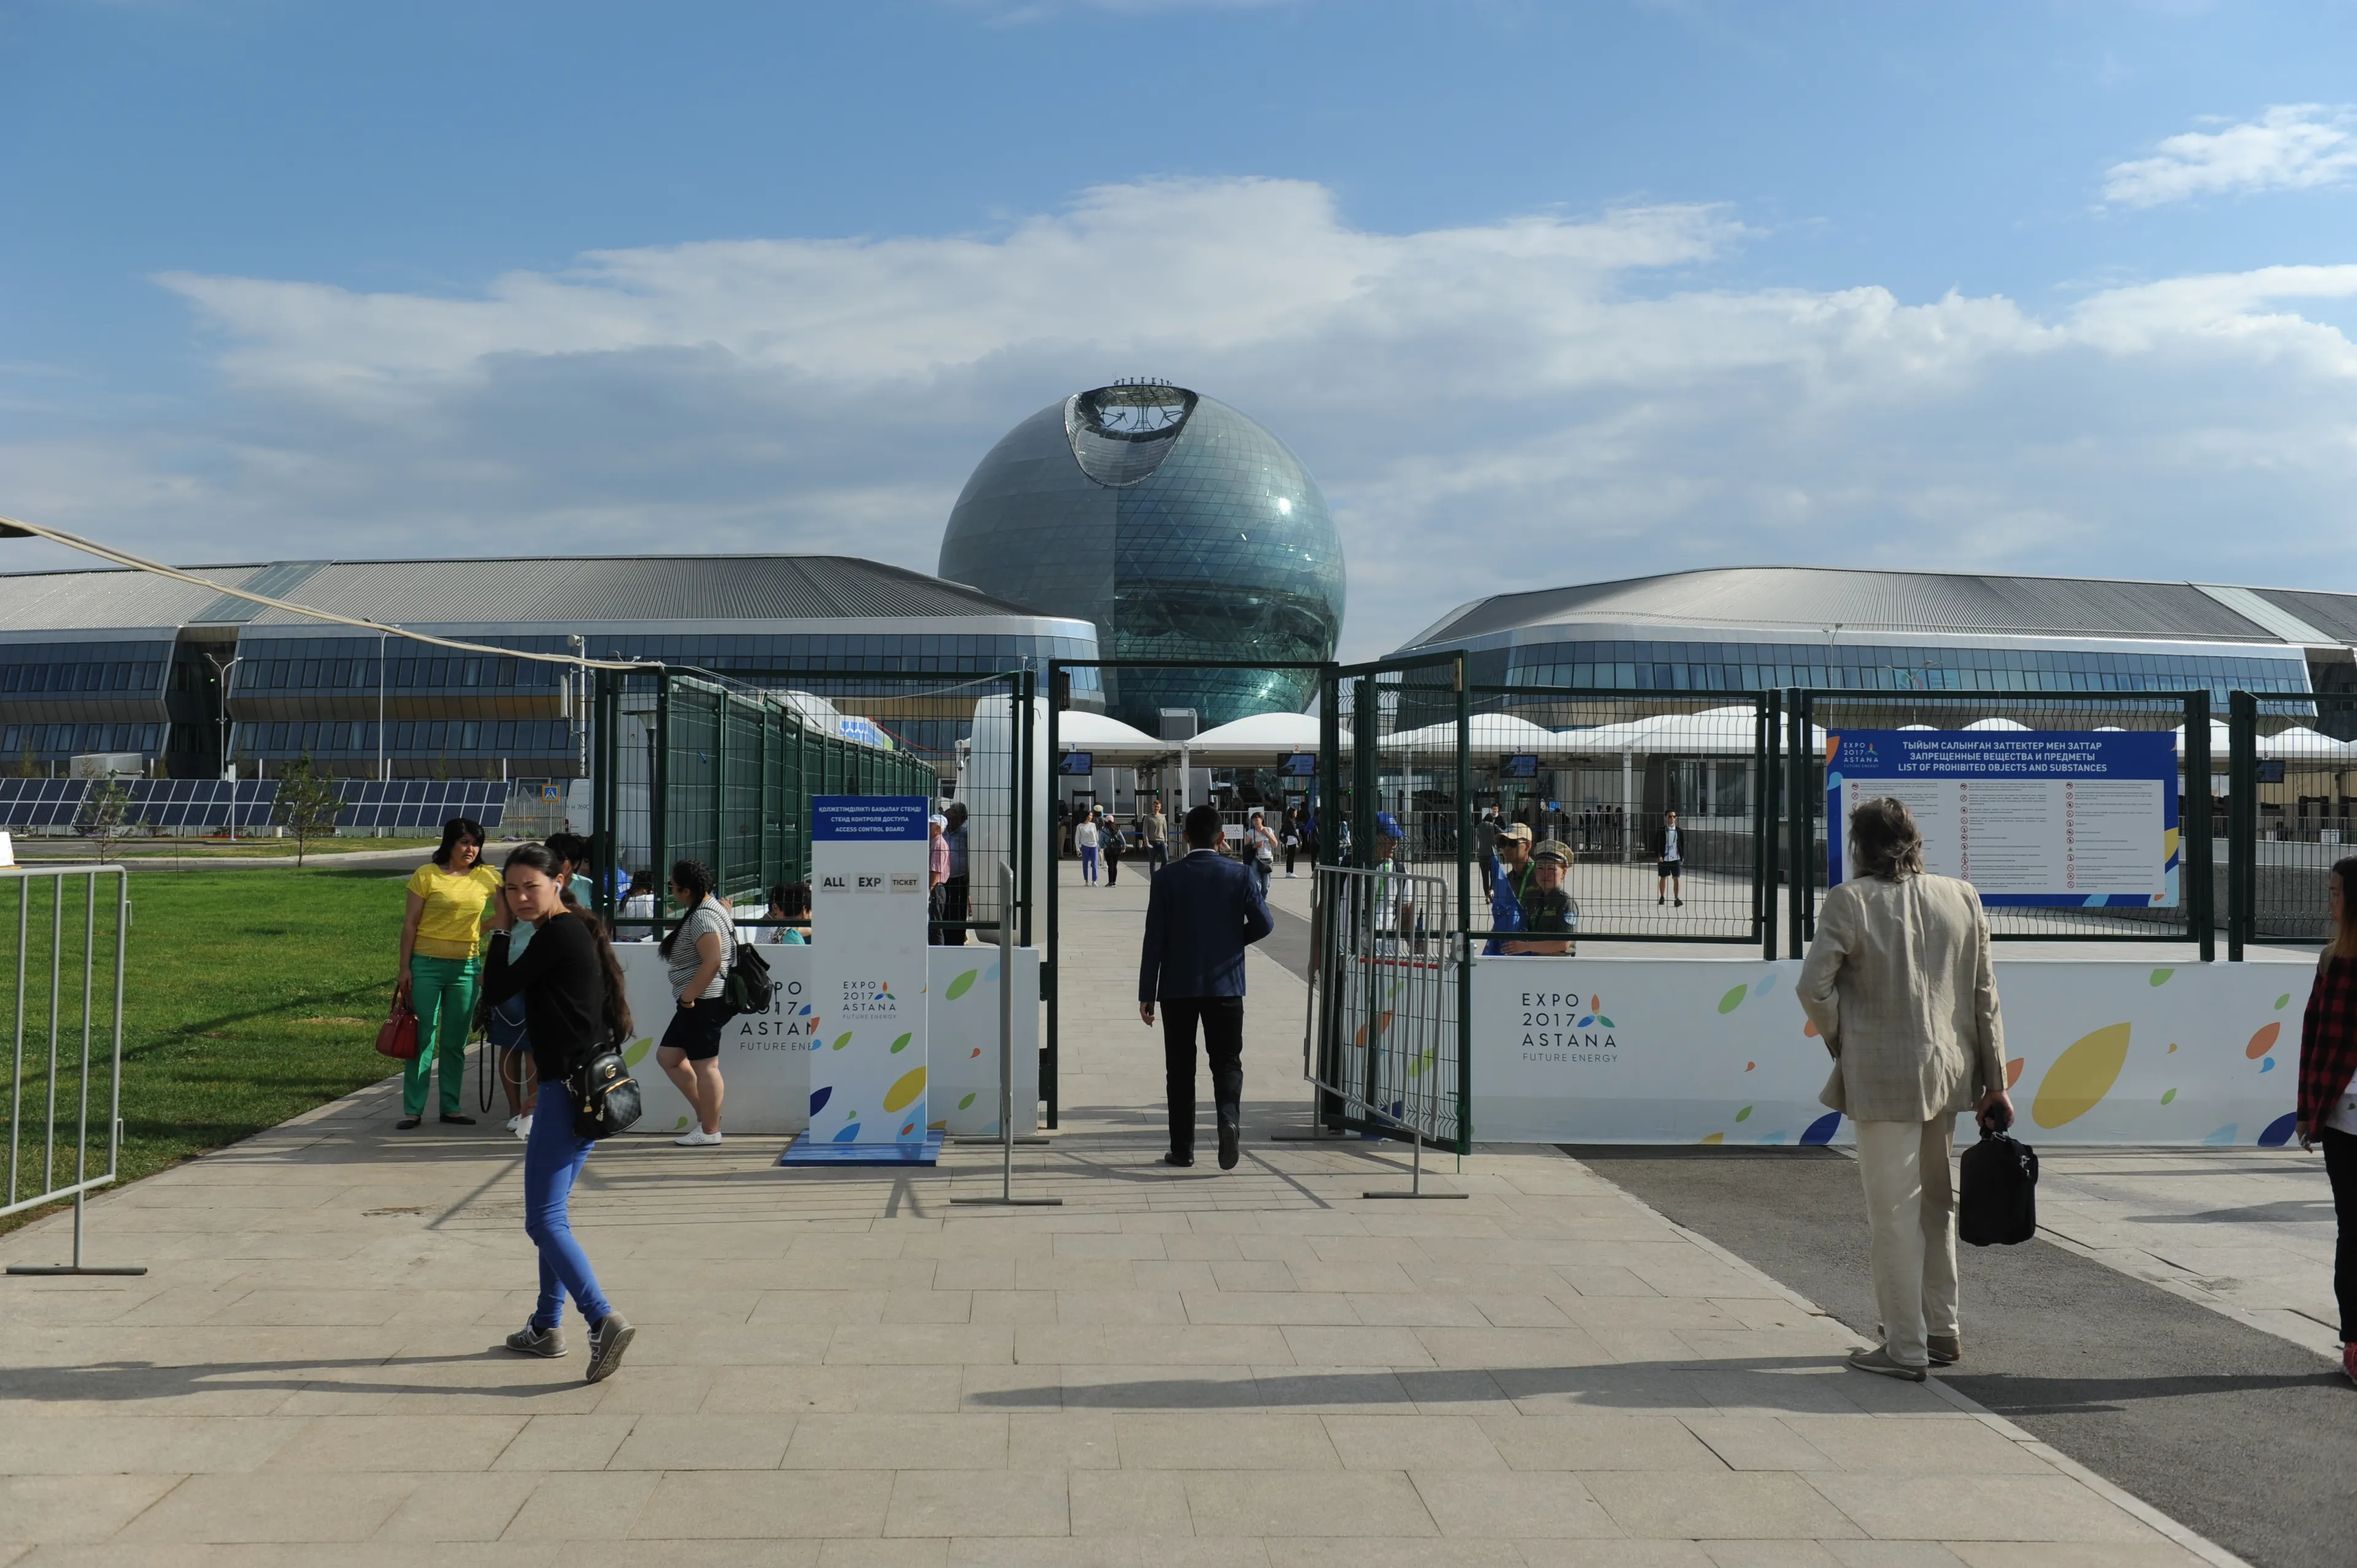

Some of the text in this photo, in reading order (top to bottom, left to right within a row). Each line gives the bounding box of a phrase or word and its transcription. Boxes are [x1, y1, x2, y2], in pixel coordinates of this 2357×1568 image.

[1903, 741, 1938, 749] ТЫЙЫМ
[1941, 741, 1991, 750] САЛЫНҒАН
[1910, 752, 1981, 762] ЗАПРЕЩЕННЫЕ
[1984, 753, 2033, 762] ВЕЩЕСТВА
[2045, 753, 2095, 762] ПРЕДМЕТЫ
[823, 878, 845, 887] ALL
[858, 878, 881, 887] EXP
[1522, 993, 1579, 1007] EXPO
[1522, 1013, 1576, 1027] 2017
[1522, 1033, 1616, 1048] ASTANA
[740, 1042, 786, 1051] FUTURE
[1523, 1053, 1618, 1062] FUTURE ENERGY
